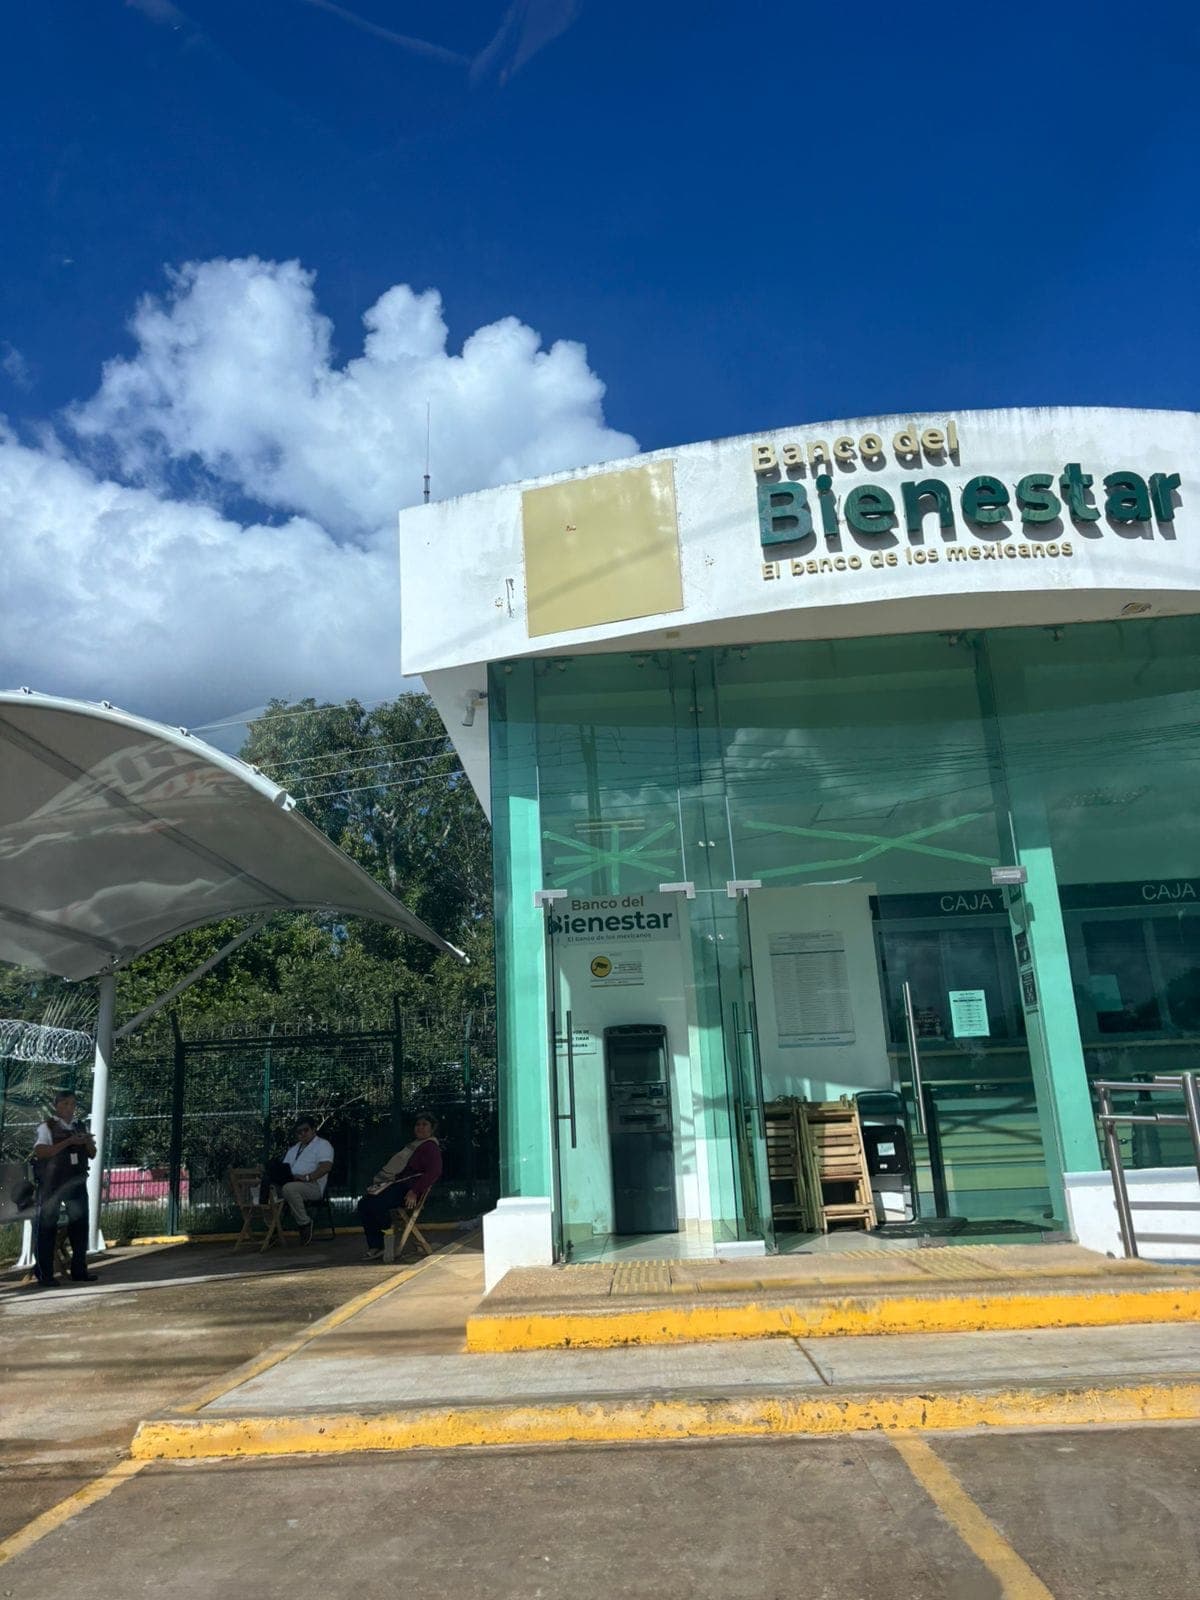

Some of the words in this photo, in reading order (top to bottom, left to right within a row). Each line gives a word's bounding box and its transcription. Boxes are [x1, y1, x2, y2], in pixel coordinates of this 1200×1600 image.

[752, 432, 883, 471] Banco
[893, 420, 960, 458] del
[757, 462, 1181, 547] Bienestar
[762, 561, 781, 581] El
[790, 555, 862, 577] banco
[870, 549, 898, 569] de
[905, 546, 939, 566] los
[946, 541, 1073, 562] mexicanos
[571, 899, 618, 911] Banco
[621, 896, 644, 908] del
[940, 893, 994, 912] CAJA
[1142, 882, 1197, 901] CAJA
